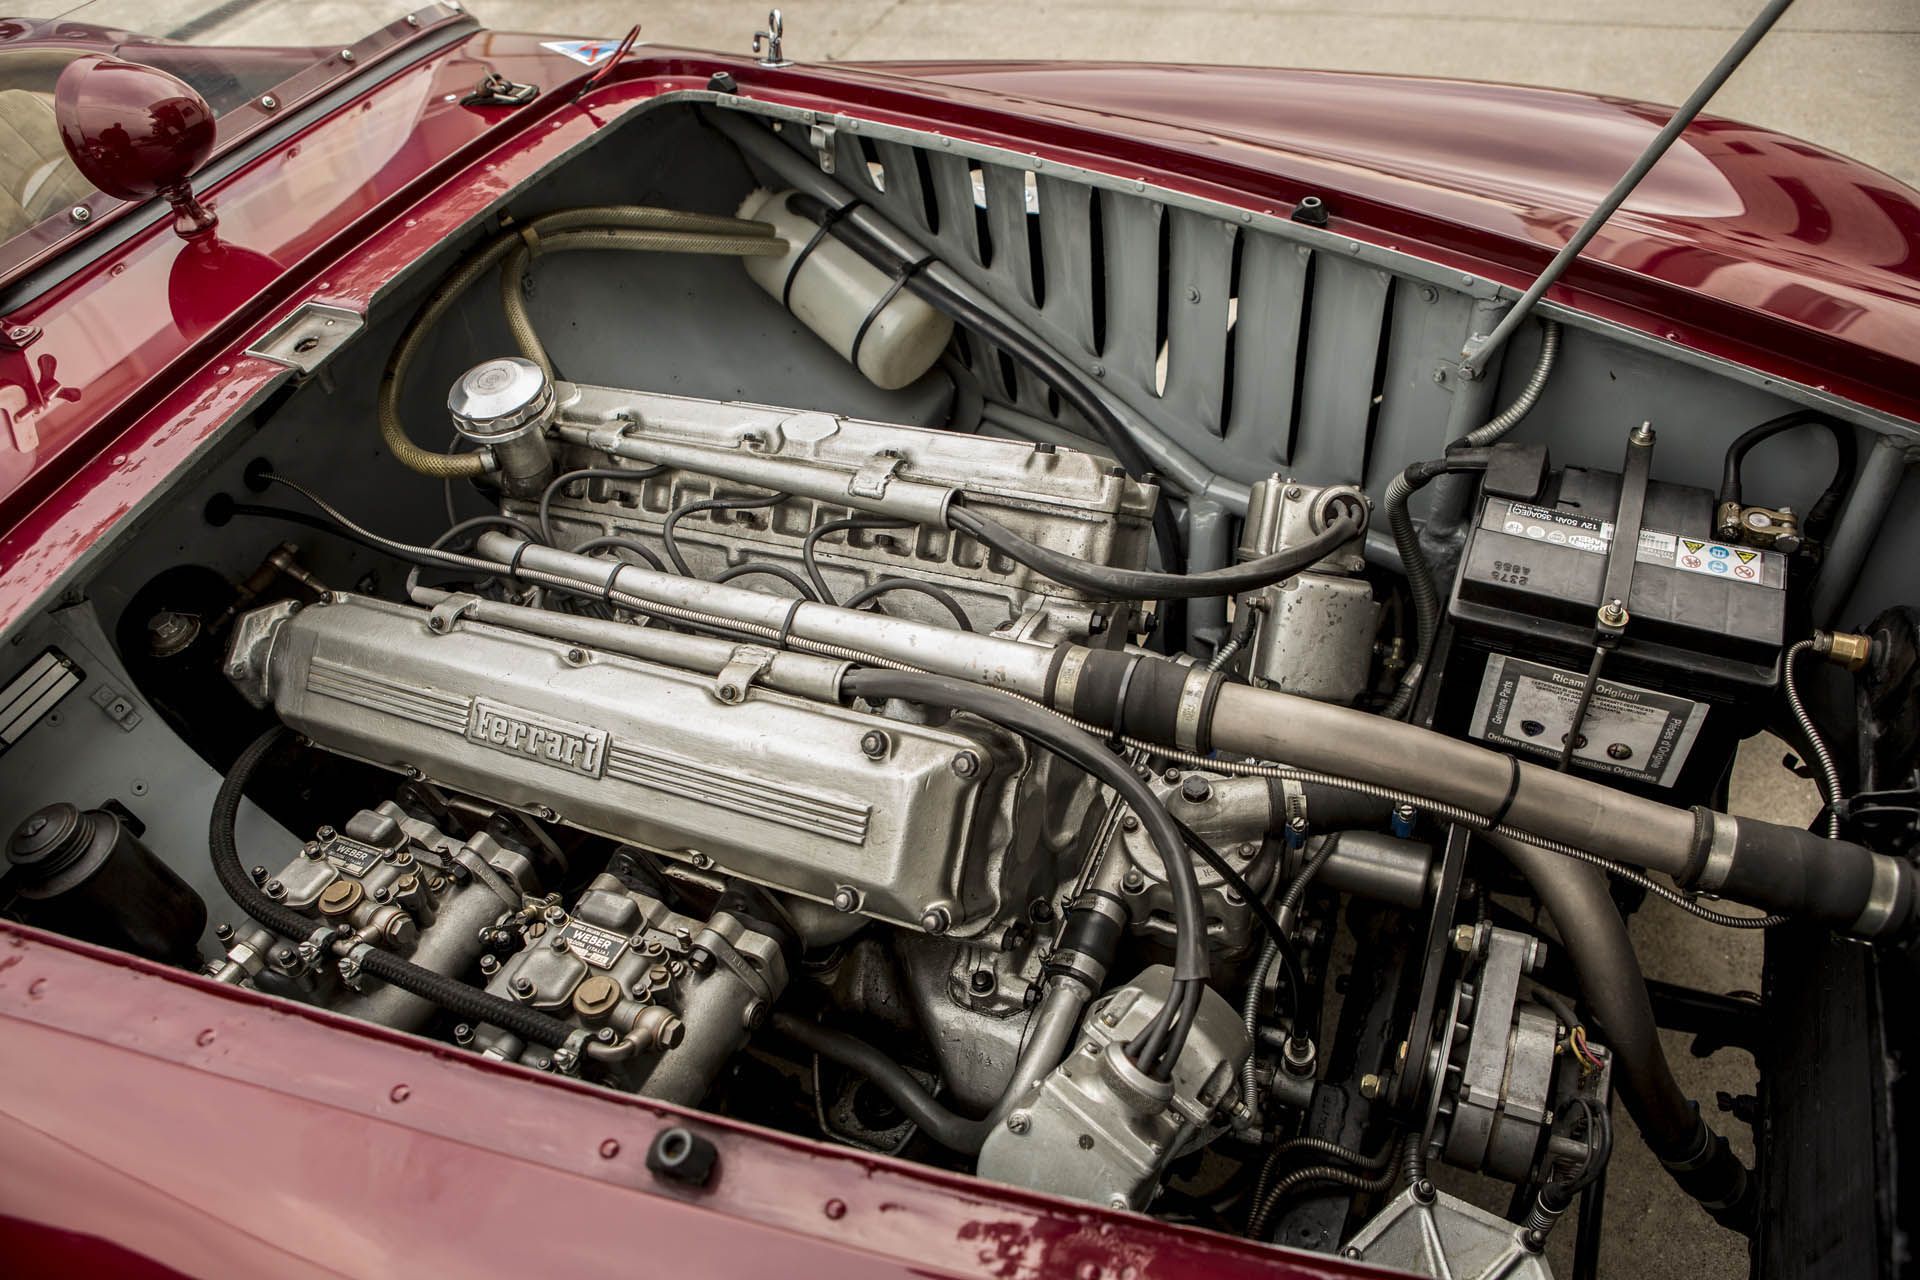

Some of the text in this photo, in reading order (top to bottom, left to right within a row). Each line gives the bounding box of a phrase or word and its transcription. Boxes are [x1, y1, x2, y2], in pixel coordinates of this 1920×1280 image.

[1555, 516, 1578, 527] 50Ah
[1580, 521, 1597, 530] 12V
[1552, 673, 1640, 701] Ricam Originali
[1491, 680, 1513, 725] Genuine Parts
[472, 703, 599, 771] Ferrari
[1487, 732, 1520, 748] Original
[1613, 766, 1657, 782] Originales
[336, 844, 368, 861] WEBER
[573, 929, 612, 950] WEBER
